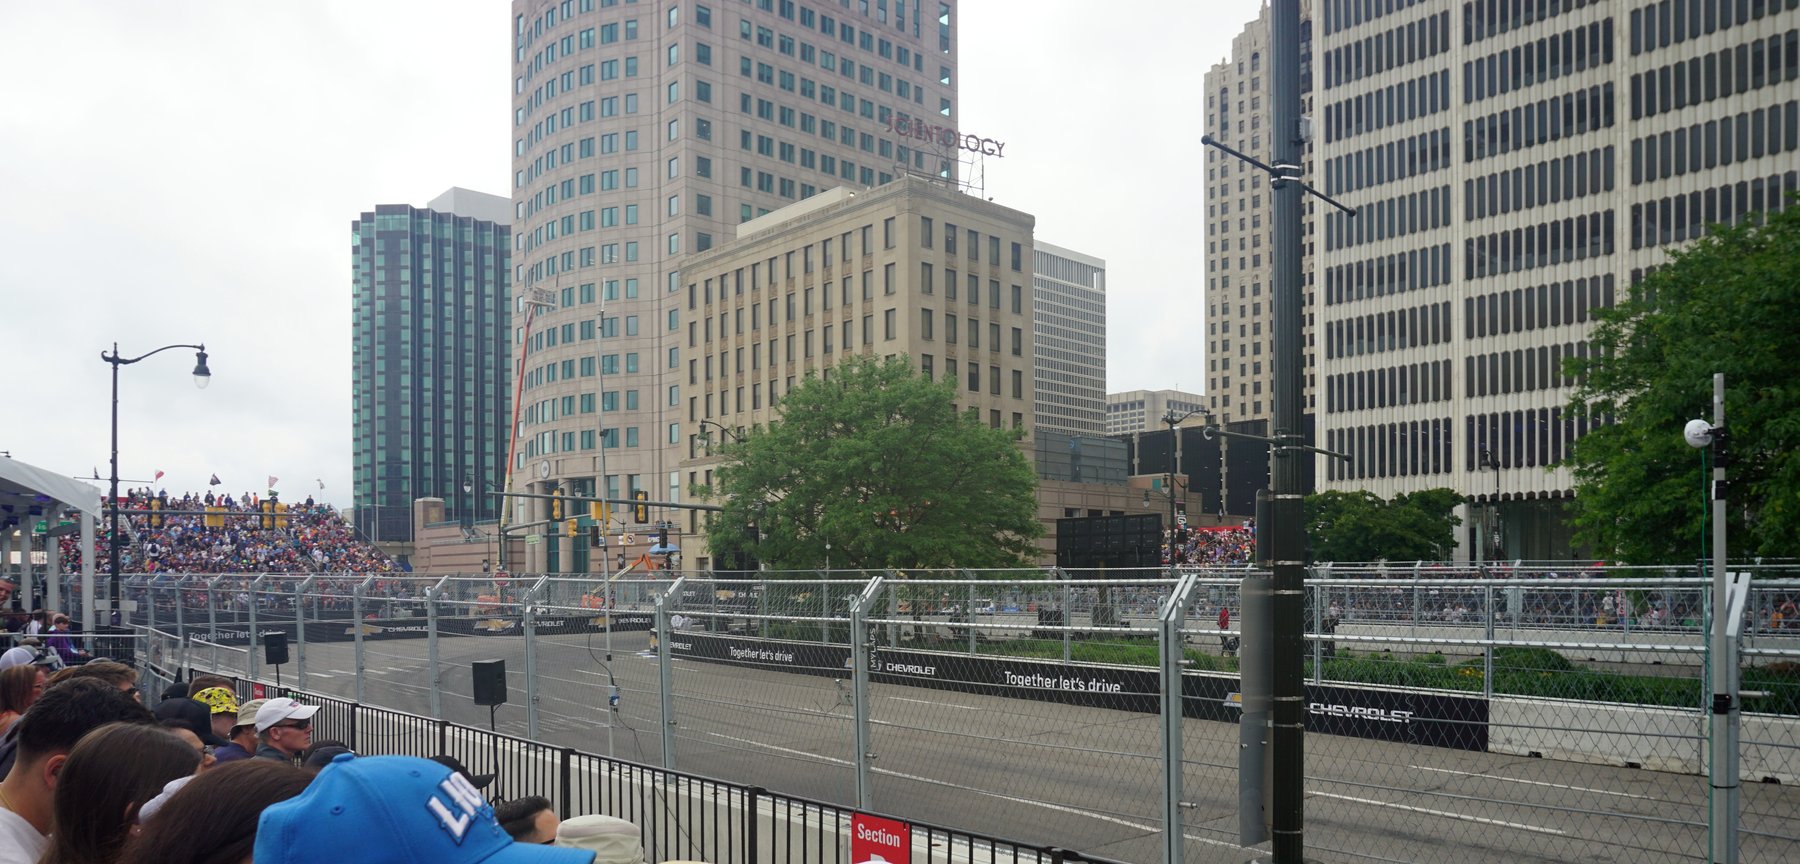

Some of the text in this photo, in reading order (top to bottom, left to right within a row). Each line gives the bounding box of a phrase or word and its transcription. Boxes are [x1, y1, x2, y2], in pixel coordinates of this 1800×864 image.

[886, 115, 1005, 158] SCIENTOLOGY
[730, 646, 758, 660] Together
[775, 652, 793, 662] drive
[886, 662, 936, 675] CHEVROLET
[1004, 671, 1120, 692] Together let's drive
[1309, 702, 1414, 723] CHEVROLET
[857, 822, 900, 848] Section
